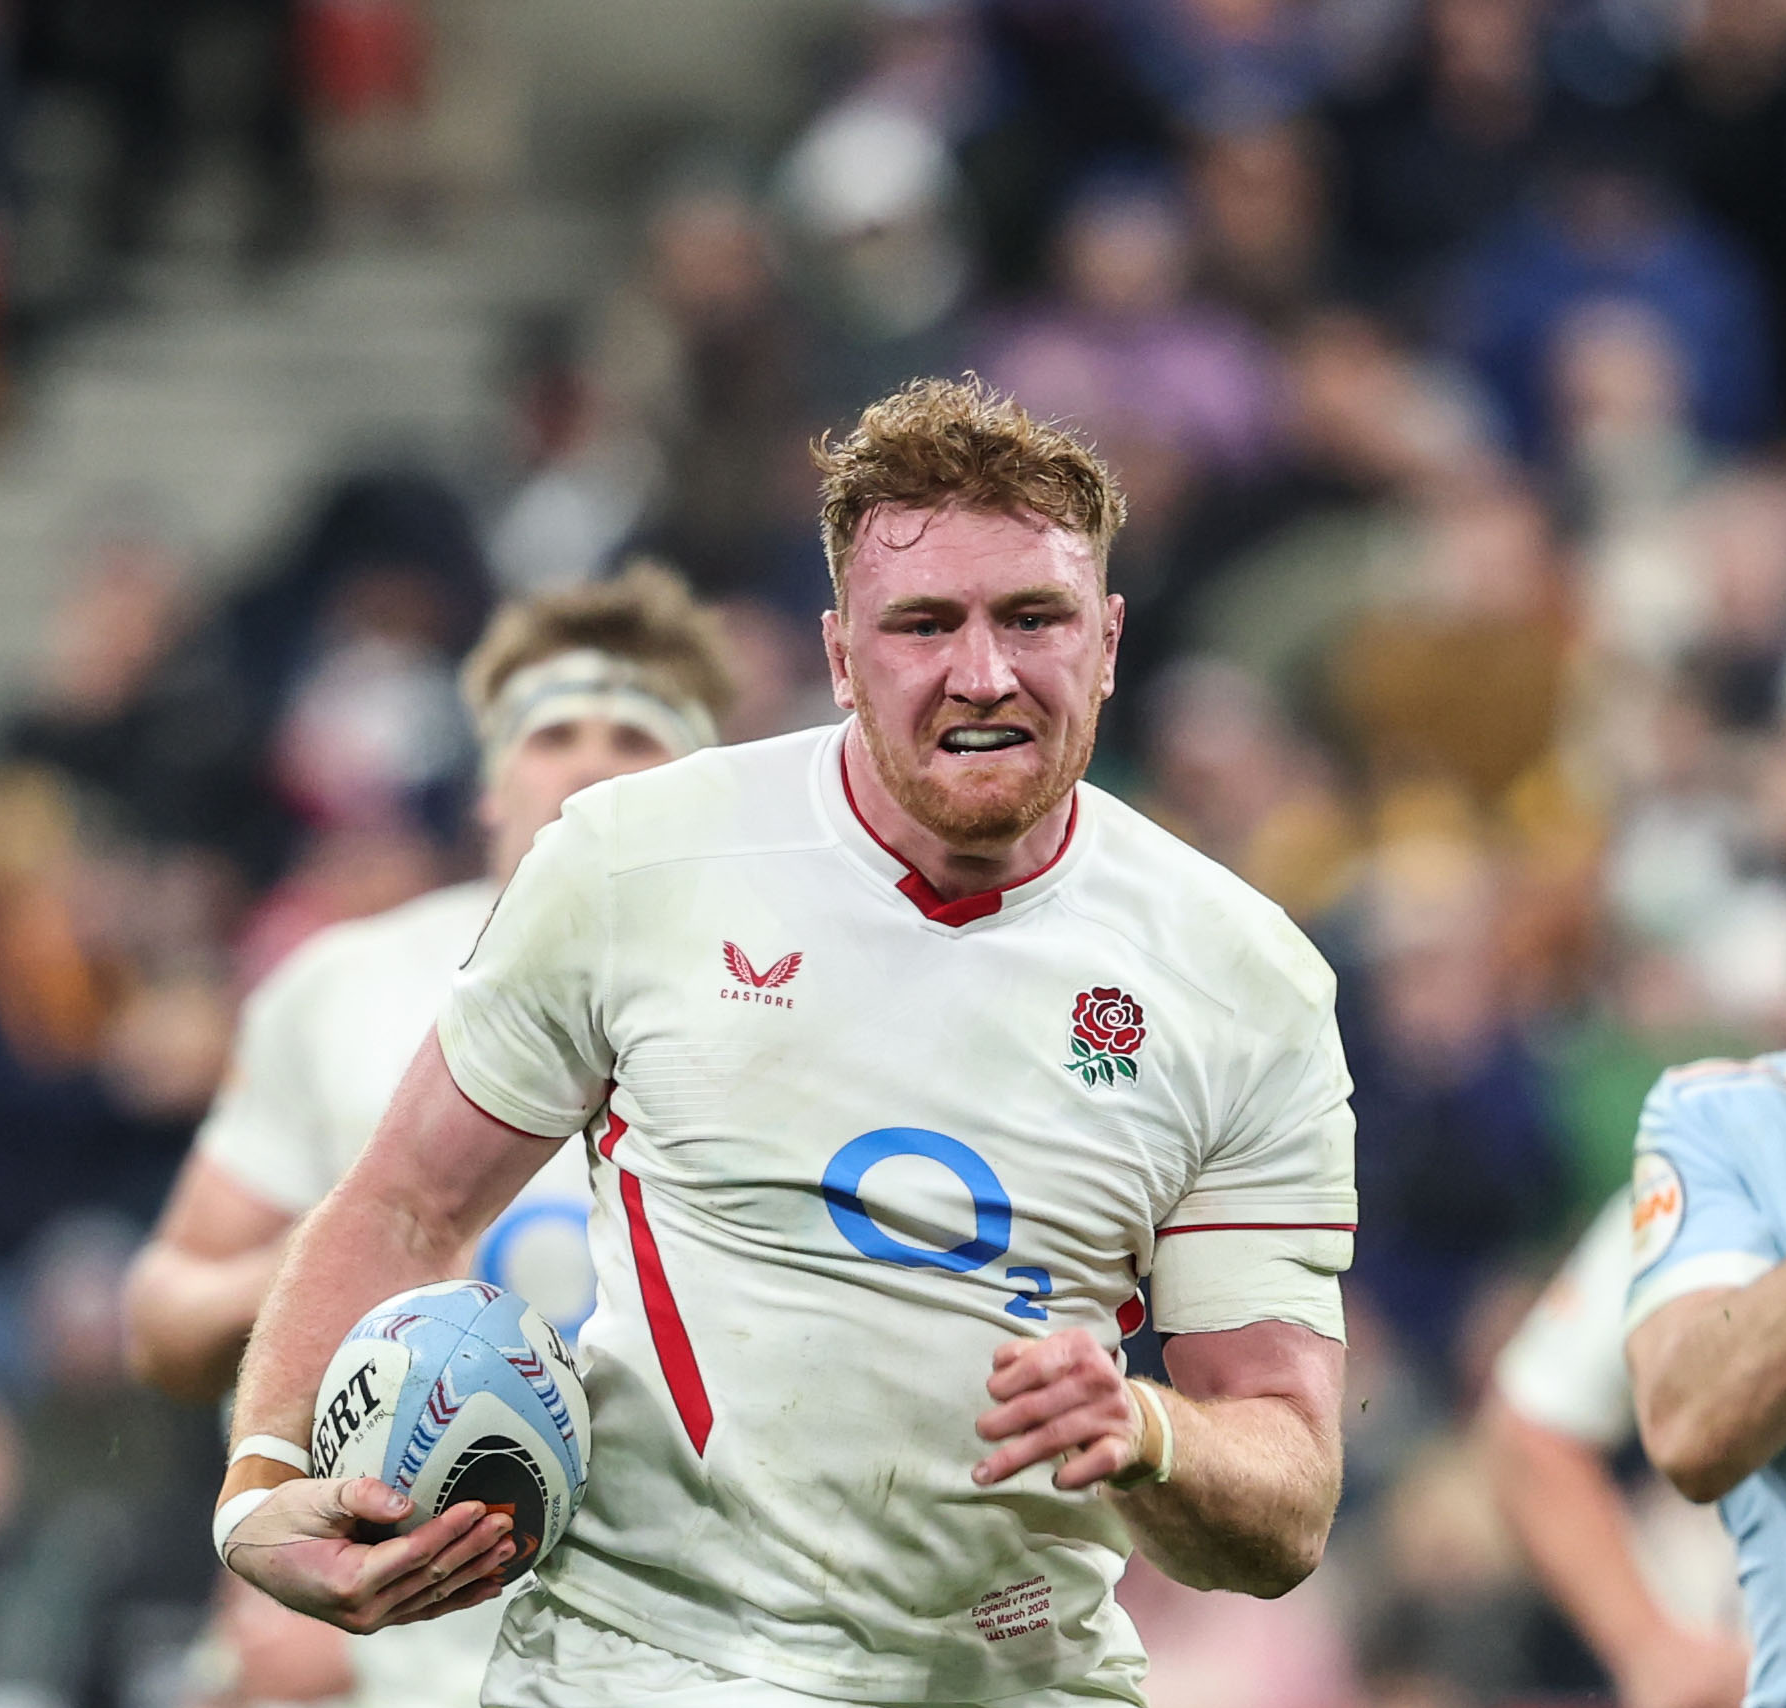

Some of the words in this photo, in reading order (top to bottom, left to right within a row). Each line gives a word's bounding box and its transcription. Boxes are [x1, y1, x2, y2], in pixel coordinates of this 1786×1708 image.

[720, 988, 794, 1009] CASTORE
[971, 1598, 1011, 1617] England
[1019, 1586, 1052, 1603] France
[975, 1617, 996, 1630] 14th
[997, 1608, 1025, 1625] March
[1027, 1599, 1050, 1616] 2026
[1006, 1624, 1028, 1638] 35th
[1028, 1617, 1049, 1631] Cap
